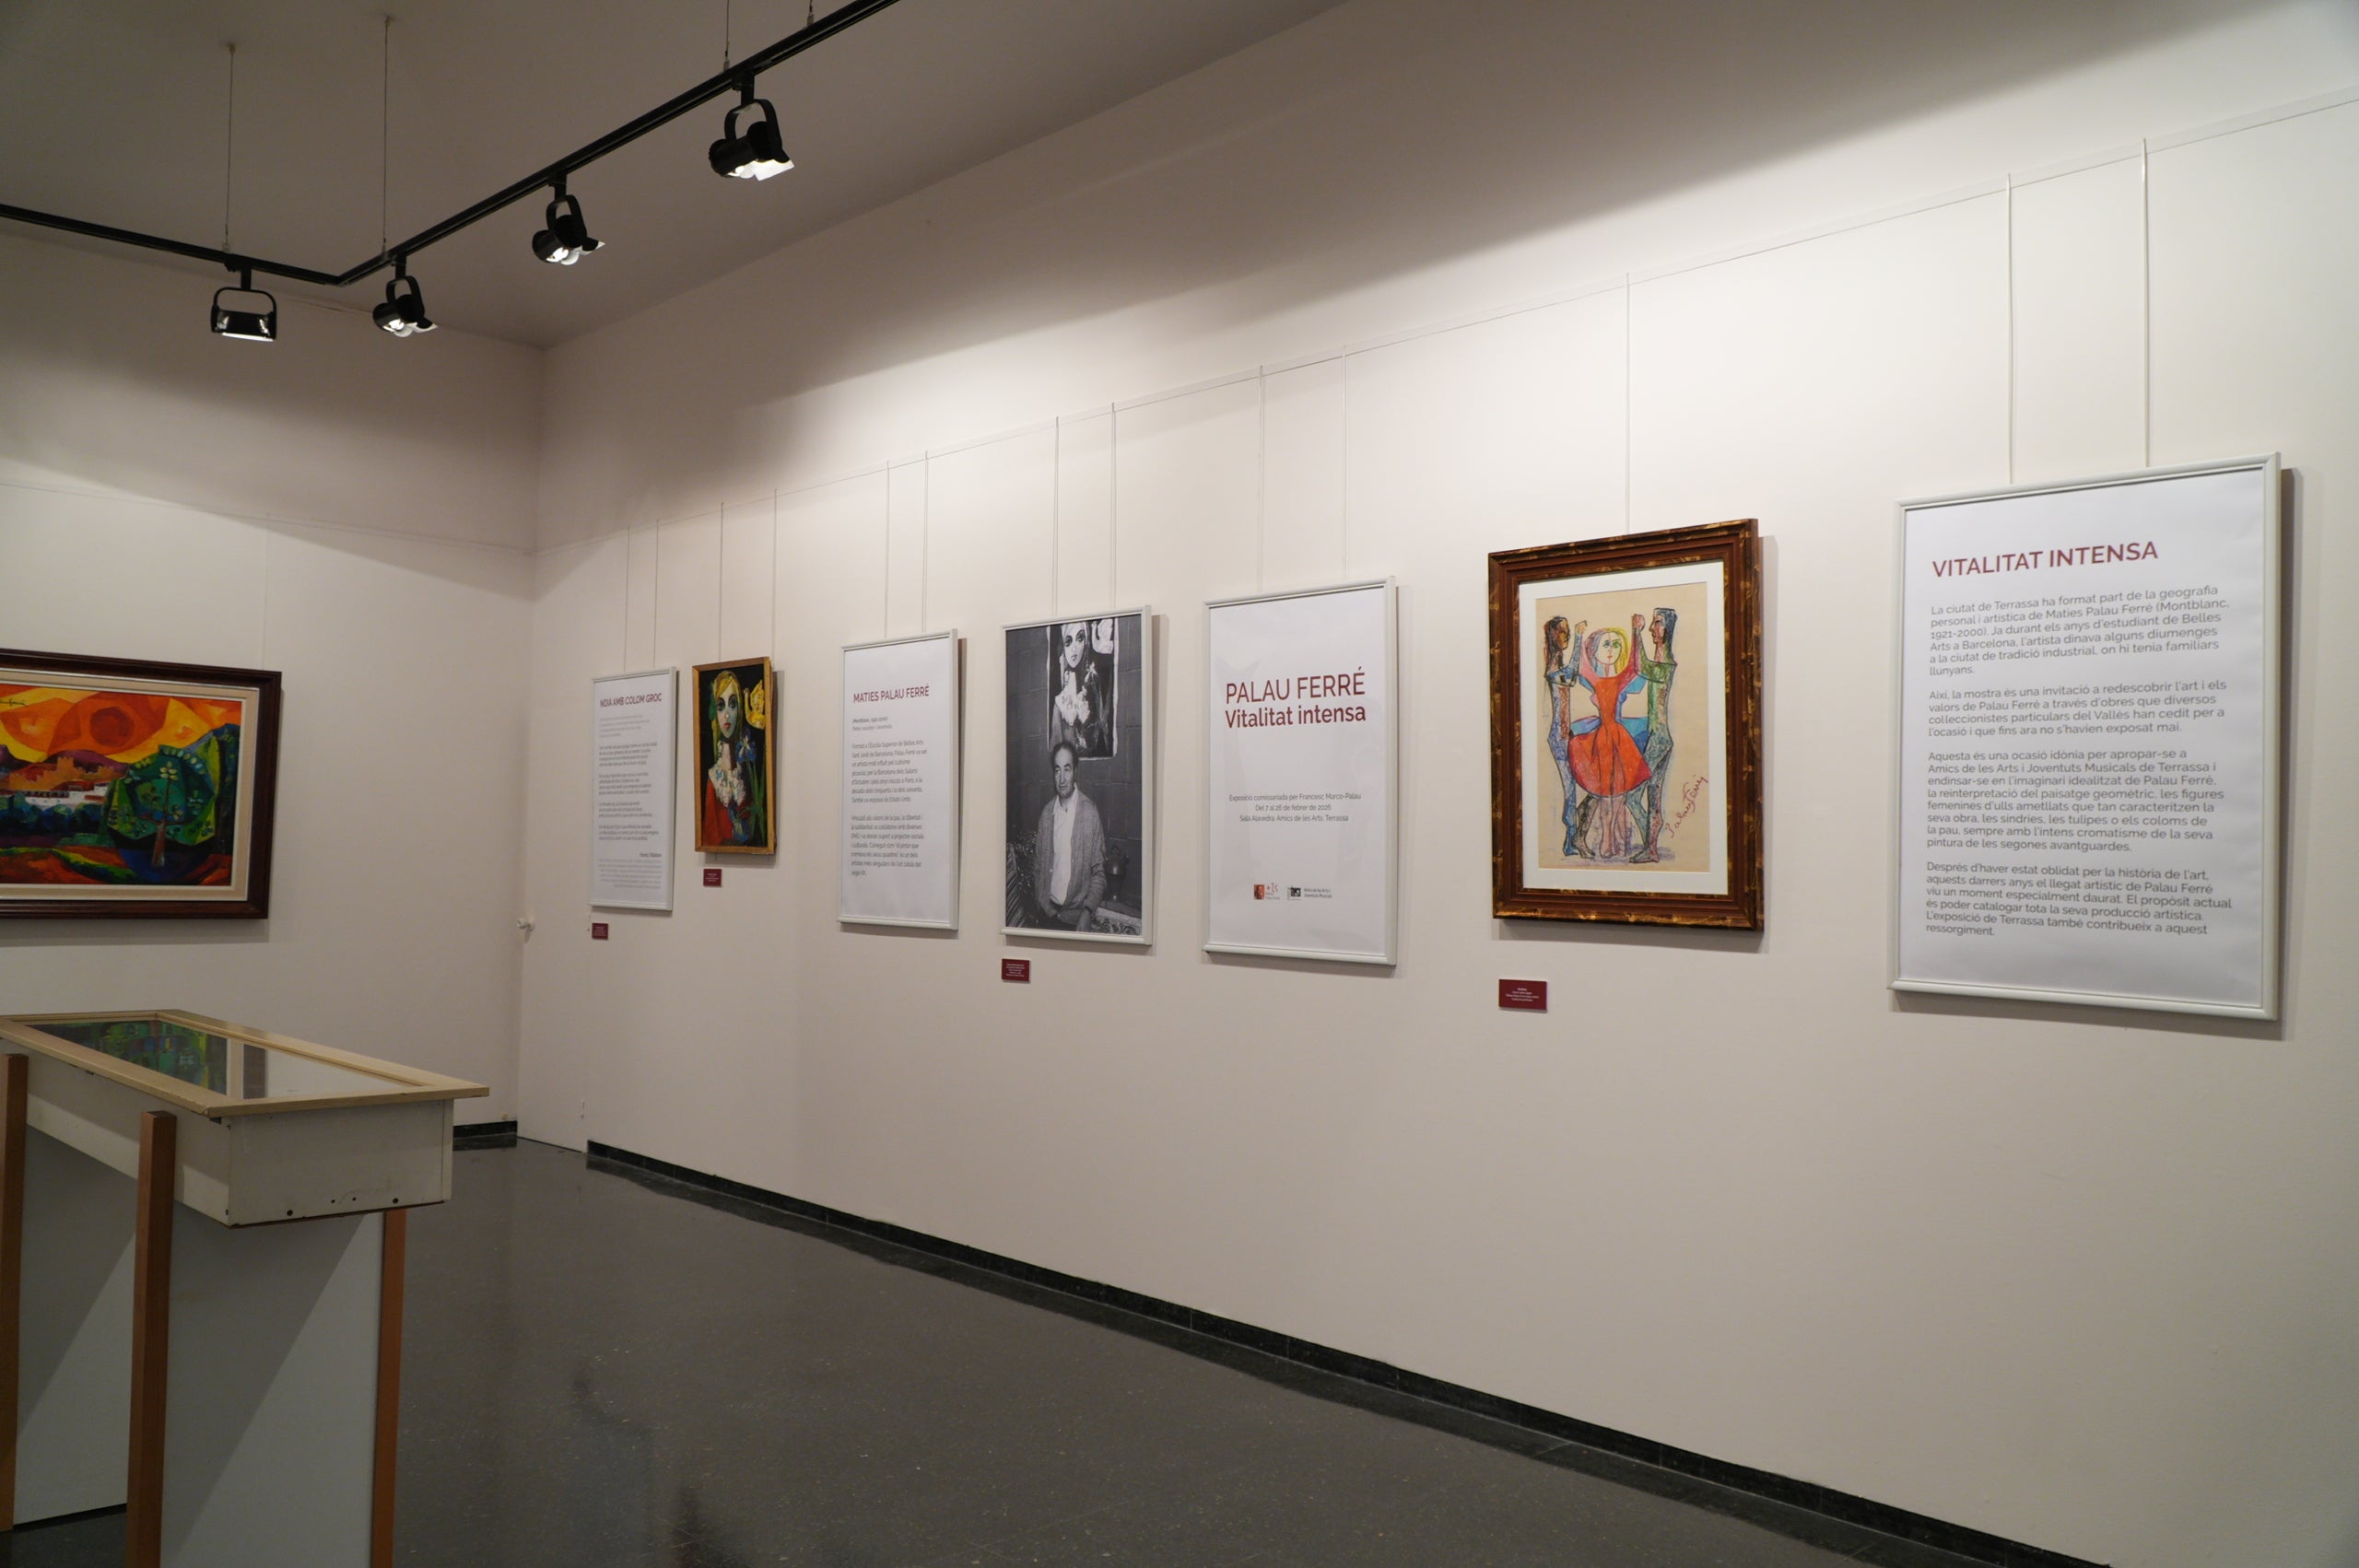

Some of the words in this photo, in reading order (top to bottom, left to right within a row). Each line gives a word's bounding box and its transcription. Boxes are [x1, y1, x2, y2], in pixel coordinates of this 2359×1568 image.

[1932, 551, 2043, 578] VITALITAT
[2049, 541, 2158, 567] INTENSA
[1931, 606, 1943, 615] La
[1945, 604, 1975, 614] ciutat
[1978, 602, 1992, 611] de
[1994, 600, 2039, 610] Terrassa
[2042, 596, 2055, 606] ha
[2058, 593, 2096, 605] format
[2099, 591, 2123, 604] part
[2126, 590, 2142, 600] de
[2145, 588, 2156, 599] la
[2158, 584, 2217, 600] geografia
[1931, 614, 1976, 629] personal
[1978, 614, 1981, 623] i
[2028, 610, 2043, 620] de
[2046, 607, 2083, 618] Maties
[2086, 605, 2118, 616] Palau
[1990, 625, 2003, 634] Ja
[2005, 623, 2041, 634] durant
[2044, 621, 2061, 632] els
[2063, 622, 2090, 632] anys
[2092, 616, 2159, 629] d'estudiant
[2162, 614, 2179, 625] de
[2181, 612, 2221, 623] Belles
[1930, 641, 1951, 651] Arts
[2020, 635, 2061, 646] l'artista
[2063, 633, 2101, 643] dinava
[2104, 631, 2144, 643] alguns
[2147, 627, 2217, 639] diumenges
[853, 691, 879, 703] MATIES
[881, 688, 904, 700] PALAU
[907, 684, 929, 698] FERRÉ
[1226, 678, 1290, 704] PALAU
[1297, 666, 1366, 698] FERRÉ
[614, 696, 624, 706] AMB
[626, 695, 645, 705] COLOM
[646, 693, 662, 702] GROC
[1928, 702, 1960, 712] valors
[1962, 701, 1977, 711] de
[1979, 700, 2009, 710] Palau
[2090, 696, 2134, 707] d'obres
[2136, 697, 2161, 708] que
[2163, 694, 2216, 705] diversos
[1226, 706, 1293, 728] Vitalitat
[1298, 705, 1366, 724] intensa
[2011, 711, 2070, 724] particulars
[2072, 709, 2091, 720] del
[2132, 708, 2155, 718] han
[2158, 707, 2190, 718] cedit
[2193, 709, 2214, 720] per
[1928, 751, 1970, 763] Aquesta
[2087, 751, 2107, 761] per
[2109, 751, 2176, 761] apropar-se
[1927, 775, 1989, 785] endinsar-se
[2008, 775, 2065, 787] l'imaginari
[2068, 775, 2122, 785] idealitzat
[2124, 775, 2141, 785] de
[2143, 775, 2177, 785] Palau
[1927, 787, 1937, 797] la
[2020, 788, 2038, 798] del
[2041, 788, 2090, 800] paisatge
[2160, 788, 2178, 799] les
[2180, 788, 2224, 801] figures
[1927, 800, 1982, 810] femenines
[1983, 800, 2014, 810] d'ulls
[2015, 800, 2069, 810] ametllats
[2071, 803, 2095, 813] que
[2097, 802, 2116, 811] tan
[2119, 801, 2200, 812] caracteritzen
[2202, 801, 2214, 812] la
[1927, 836, 1963, 848] pintura
[1965, 837, 1979, 847] de
[1981, 838, 1998, 848] les
[2000, 841, 2047, 851] segones
[1926, 875, 1966, 885] aquests
[1968, 875, 2006, 885] darrers
[2008, 879, 2033, 889] anys
[2036, 877, 2047, 887] el
[2049, 877, 2081, 890] llegat
[2125, 880, 2142, 891] de
[2144, 881, 2177, 892] Palau
[1926, 886, 1941, 895] viu
[1958, 889, 2003, 898] moment
[2005, 890, 2080, 901] especialment
[2126, 893, 2138, 904] El
[2193, 897, 2232, 908] actual
[1940, 899, 1971, 910] poder
[1972, 901, 2023, 913] catalogar
[2025, 903, 2047, 913] tota
[2049, 903, 2059, 913] la
[2062, 906, 2088, 915] seva
[1982, 913, 1997, 923] de
[1999, 914, 2044, 926] Terrassa
[2086, 919, 2151, 931] contribueix
[2165, 924, 2207, 934] aquest
